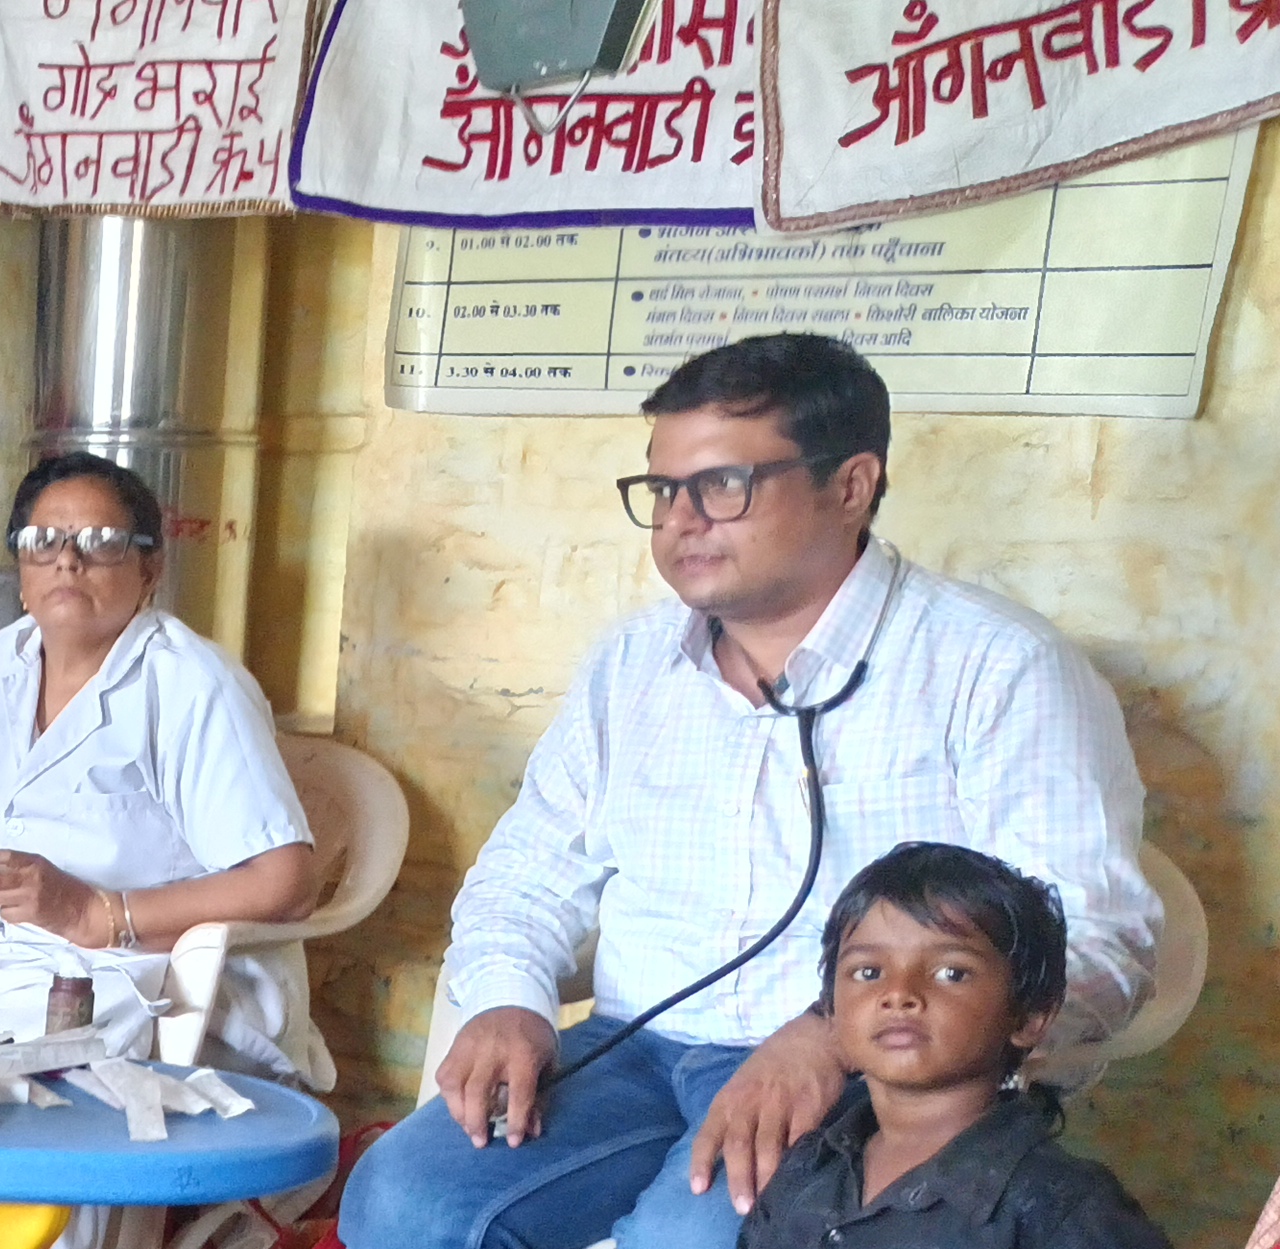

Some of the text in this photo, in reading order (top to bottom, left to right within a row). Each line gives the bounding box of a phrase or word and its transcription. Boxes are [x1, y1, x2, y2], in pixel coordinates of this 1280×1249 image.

[38, 34, 277, 128] गोद भराई
[514, 234, 552, 249] 02.00
[555, 232, 579, 247] तक
[453, 305, 487, 319] 02.00
[503, 304, 538, 319] 03.30
[866, 302, 918, 322] किशोरी
[921, 302, 977, 321] बालिका
[978, 301, 1030, 322] योजना
[879, 327, 912, 347] आदि
[500, 366, 542, 379] 04.00
